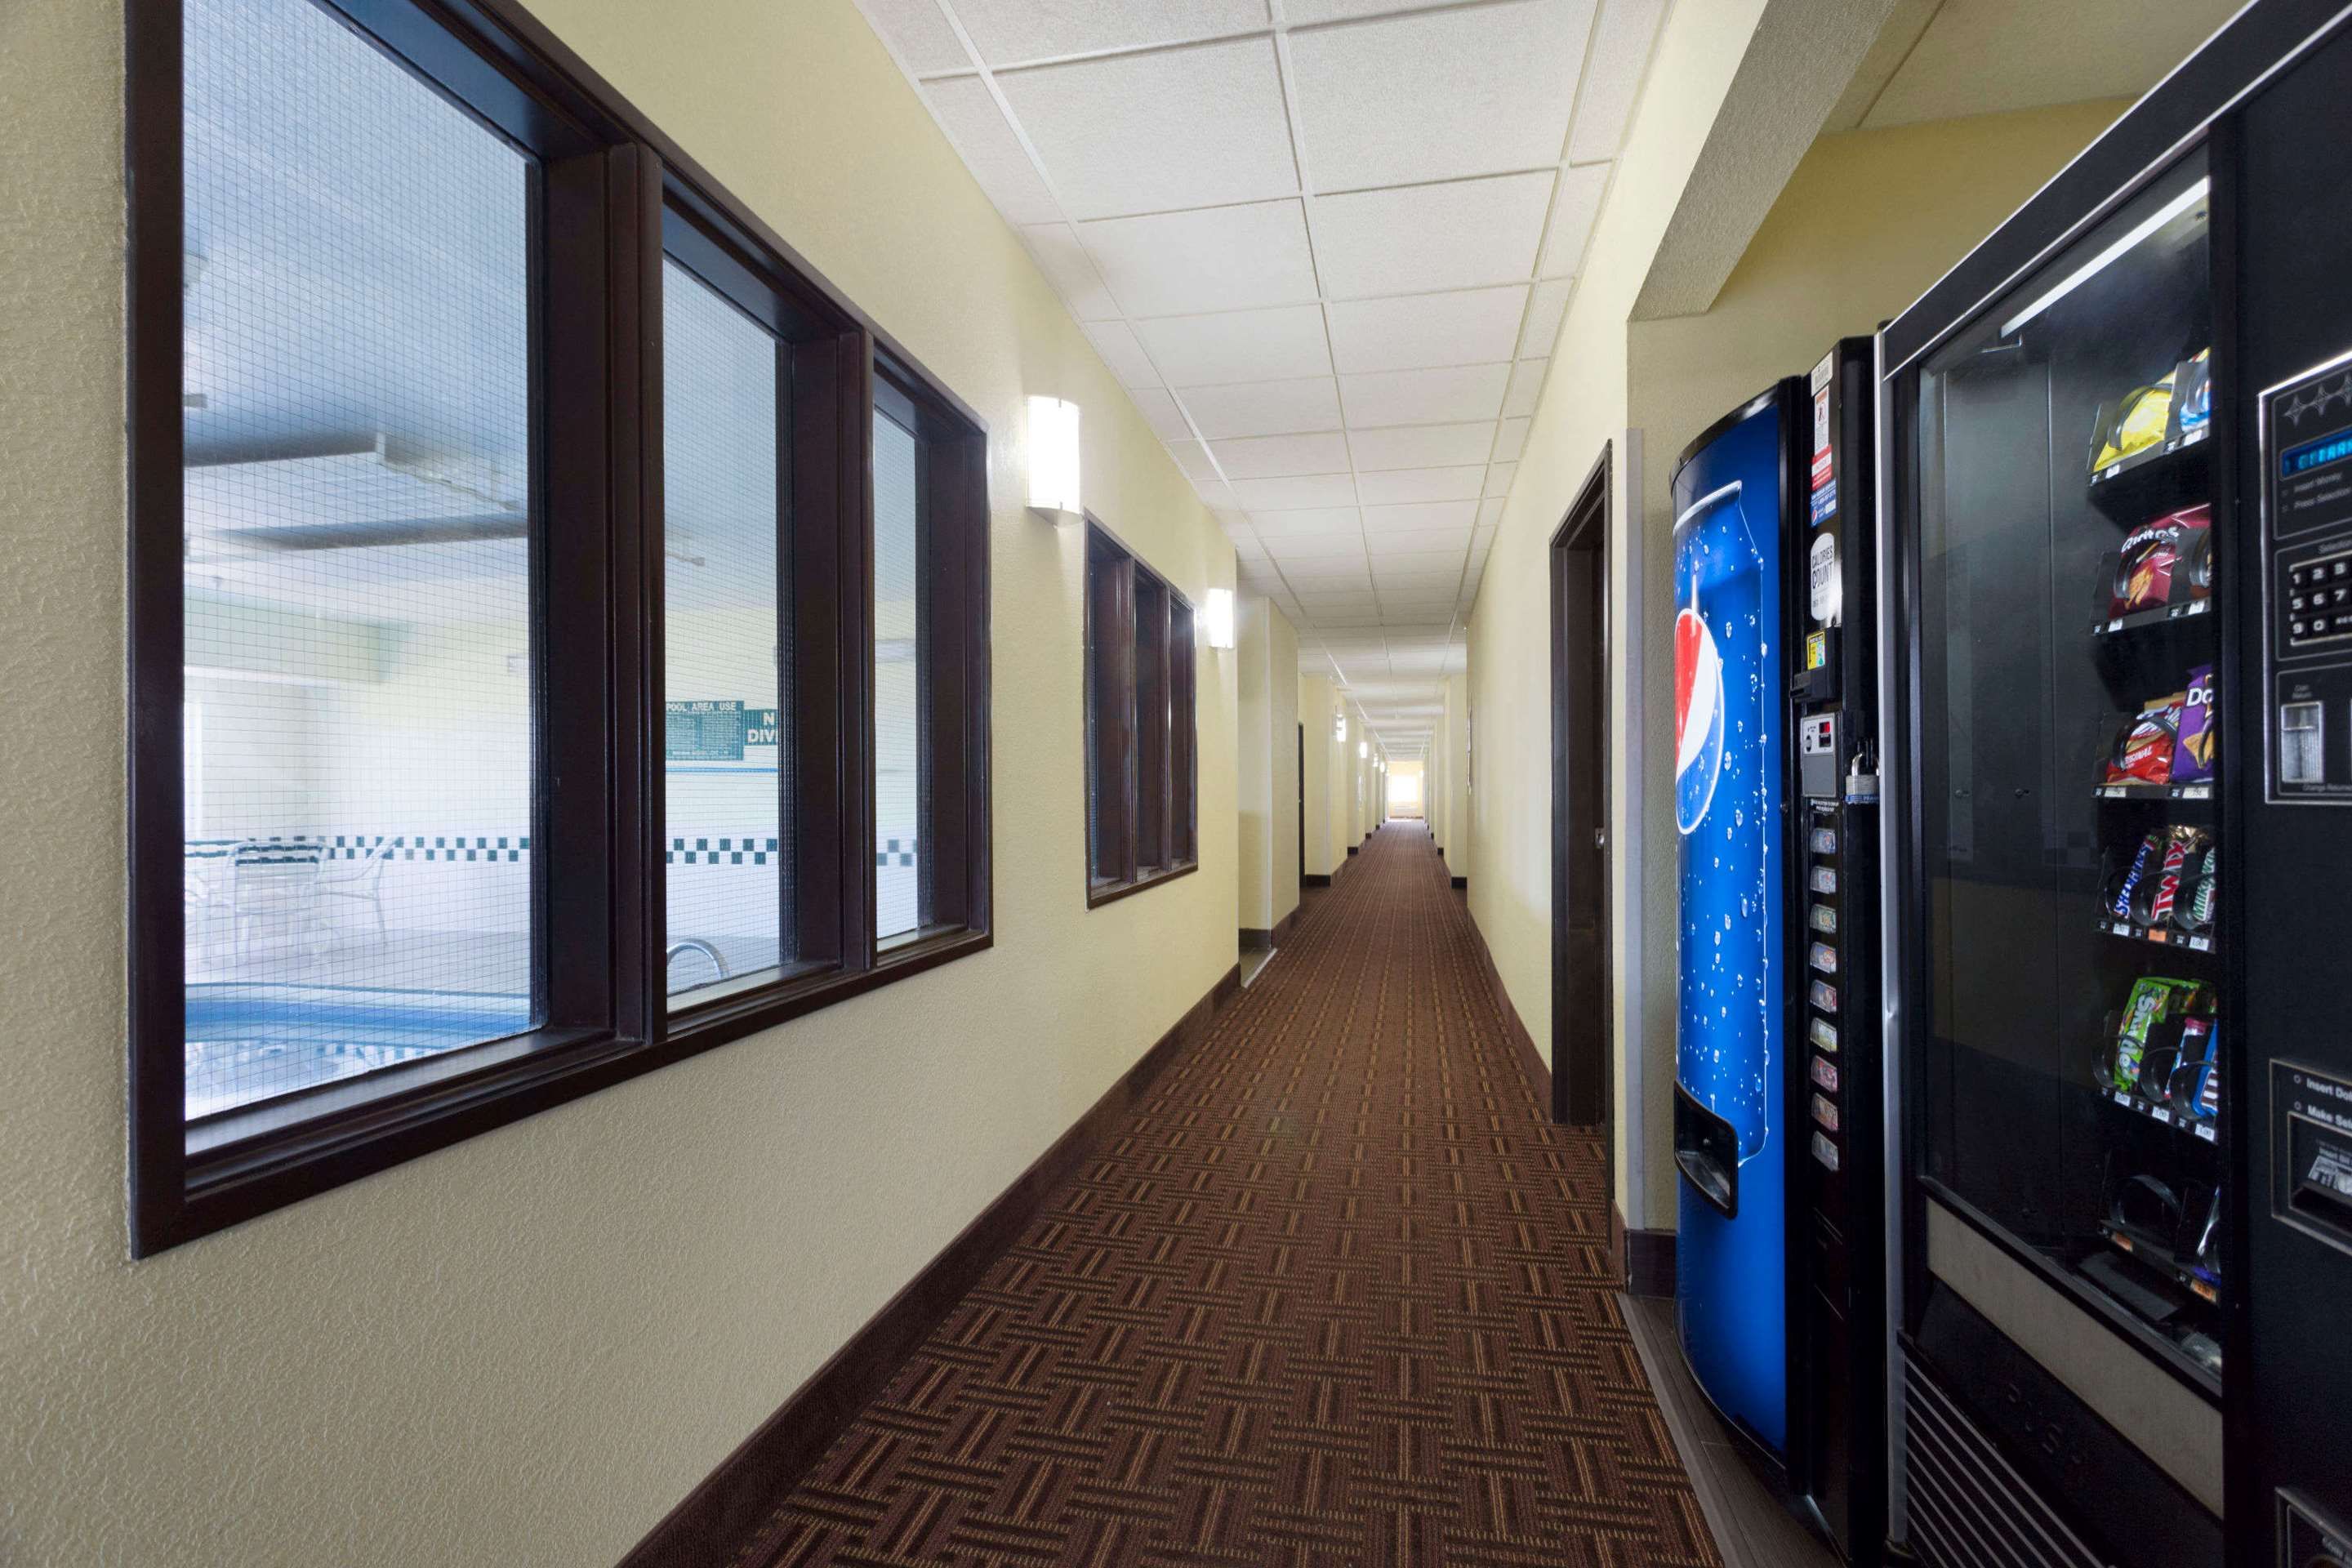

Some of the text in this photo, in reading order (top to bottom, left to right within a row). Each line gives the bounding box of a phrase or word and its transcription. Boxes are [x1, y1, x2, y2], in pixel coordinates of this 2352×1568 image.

[1811, 545, 1833, 569] CALORIES
[1811, 562, 1833, 589] COUNT
[2292, 562, 2346, 584] 1 2 3
[2292, 589, 2347, 609] 5 6 7
[2292, 622, 2304, 635] 9
[2313, 619, 2325, 631] 0
[666, 702, 737, 712] POOL AREA USE
[2306, 1077, 2333, 1096] Insert
[2307, 1104, 2333, 1123] Make
